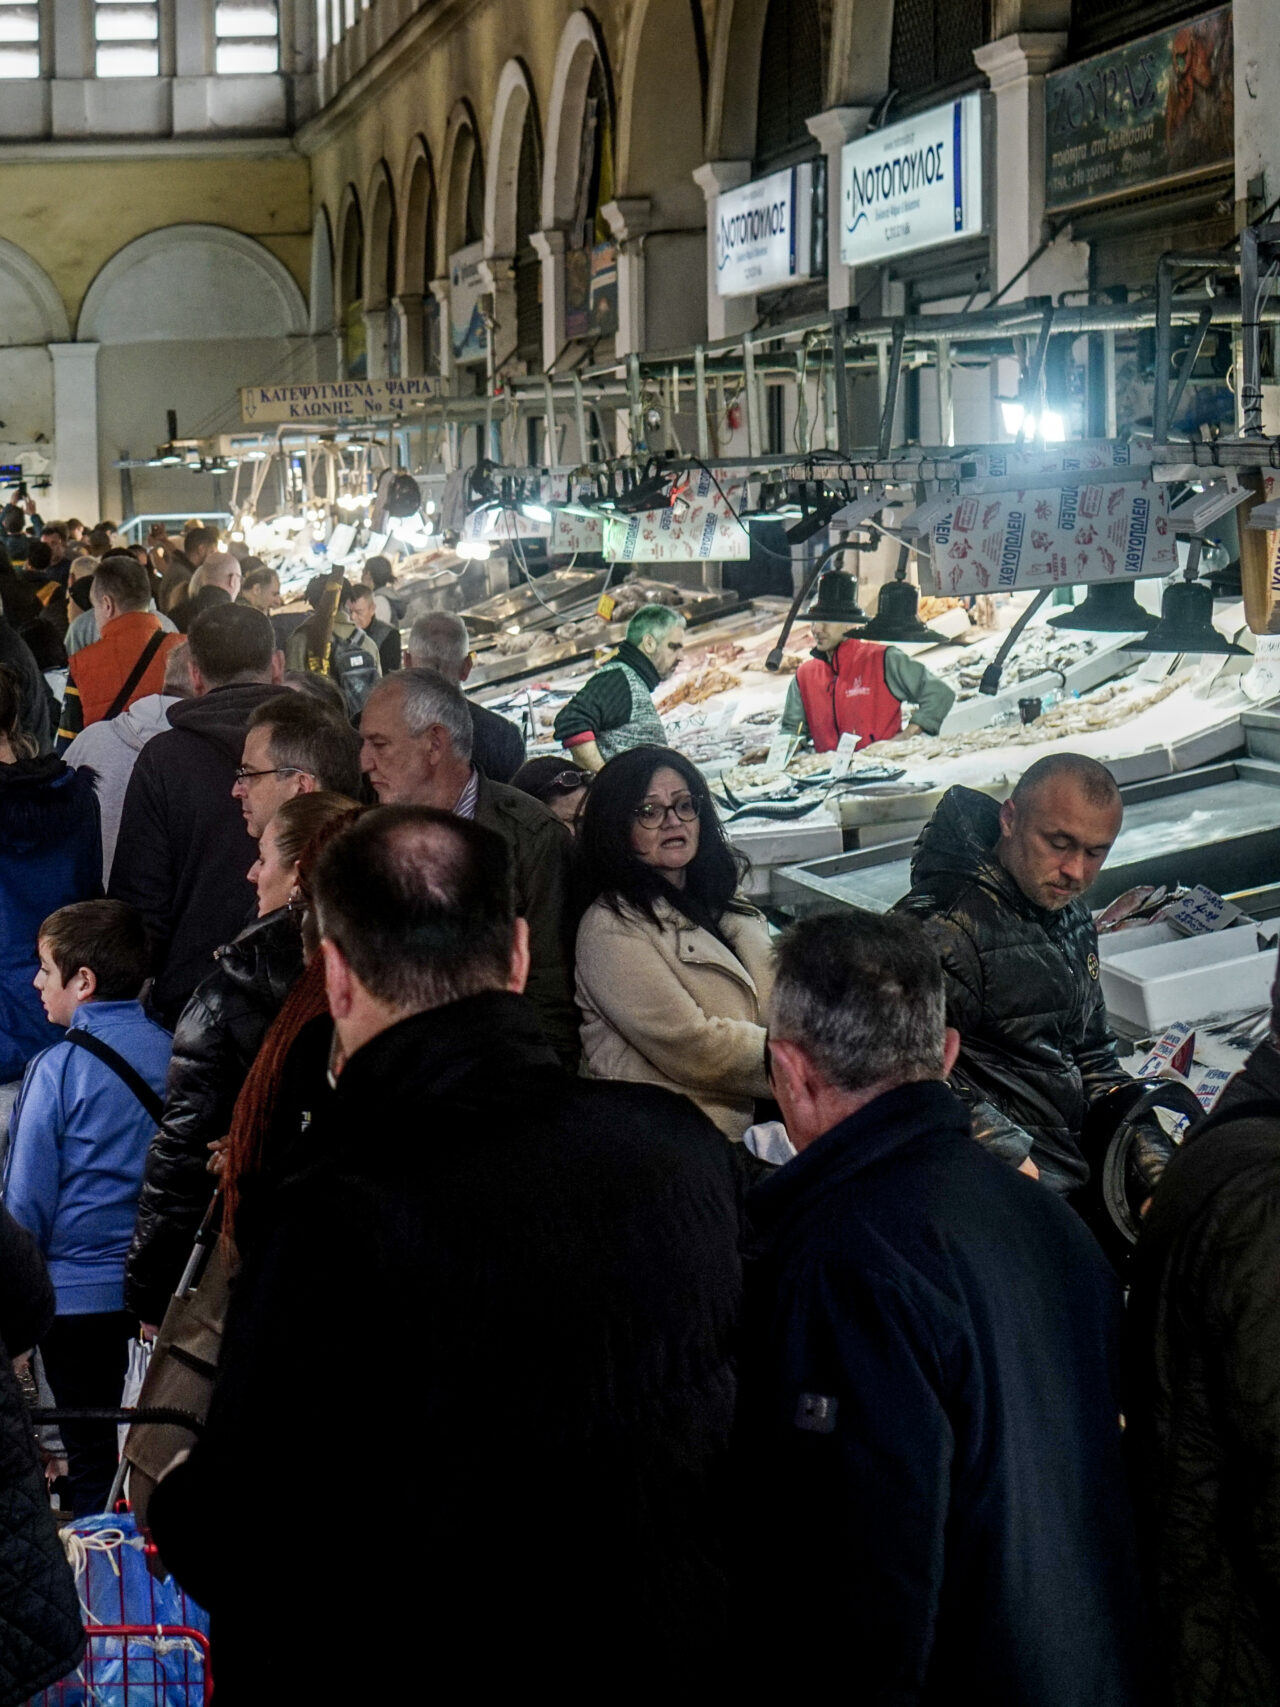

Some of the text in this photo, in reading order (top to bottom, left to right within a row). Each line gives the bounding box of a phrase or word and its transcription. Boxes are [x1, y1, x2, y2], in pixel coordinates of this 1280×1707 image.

[852, 141, 944, 218] ΝΟΤΟΠΟΥΛΟΣ
[720, 201, 786, 257] ΝΟΤΟΠΟΥΛΟΣ
[260, 382, 375, 403] ΚΑΤΕΨΥΓΜΕΝΑ
[385, 379, 432, 395] ΨΑΡΙΑ
[998, 511, 1023, 586] ΙΧΘΥΟΠΩΛΕΙΟ
[1124, 497, 1147, 573] ΙΧΘΥΟΠΩΛΕΙΟ
